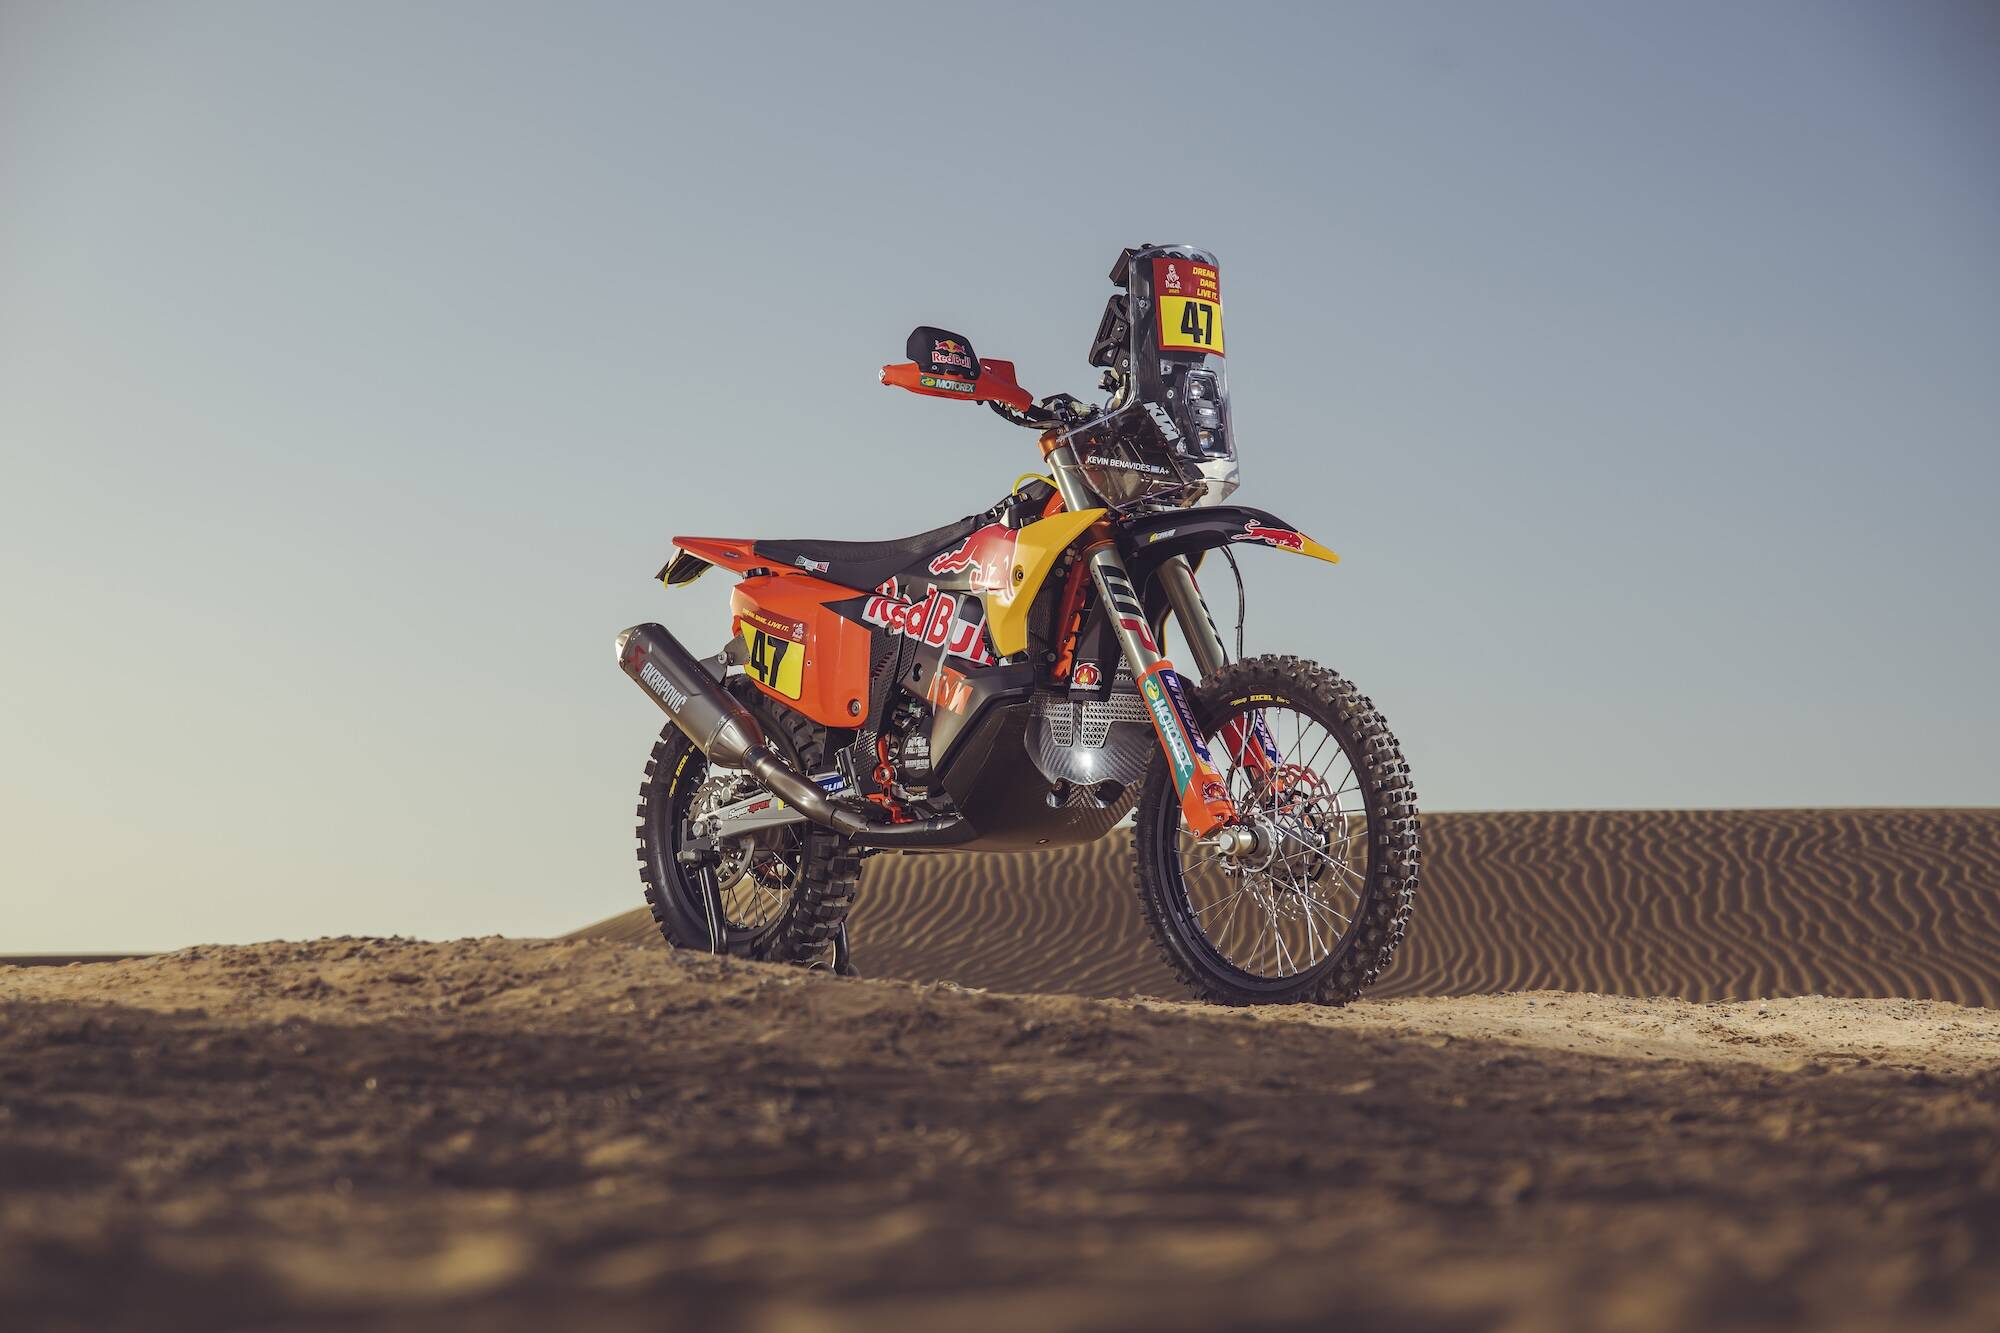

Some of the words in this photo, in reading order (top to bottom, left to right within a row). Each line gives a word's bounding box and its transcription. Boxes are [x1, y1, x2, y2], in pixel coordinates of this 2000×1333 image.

[1196, 288, 1211, 298] LIVE
[1180, 301, 1213, 345] 47
[935, 379, 975, 393] MOTOREX
[1143, 402, 1181, 442] KTM
[1087, 456, 1109, 466] KEVIN
[1109, 459, 1151, 473] BENAVIDES
[751, 629, 790, 689] 47
